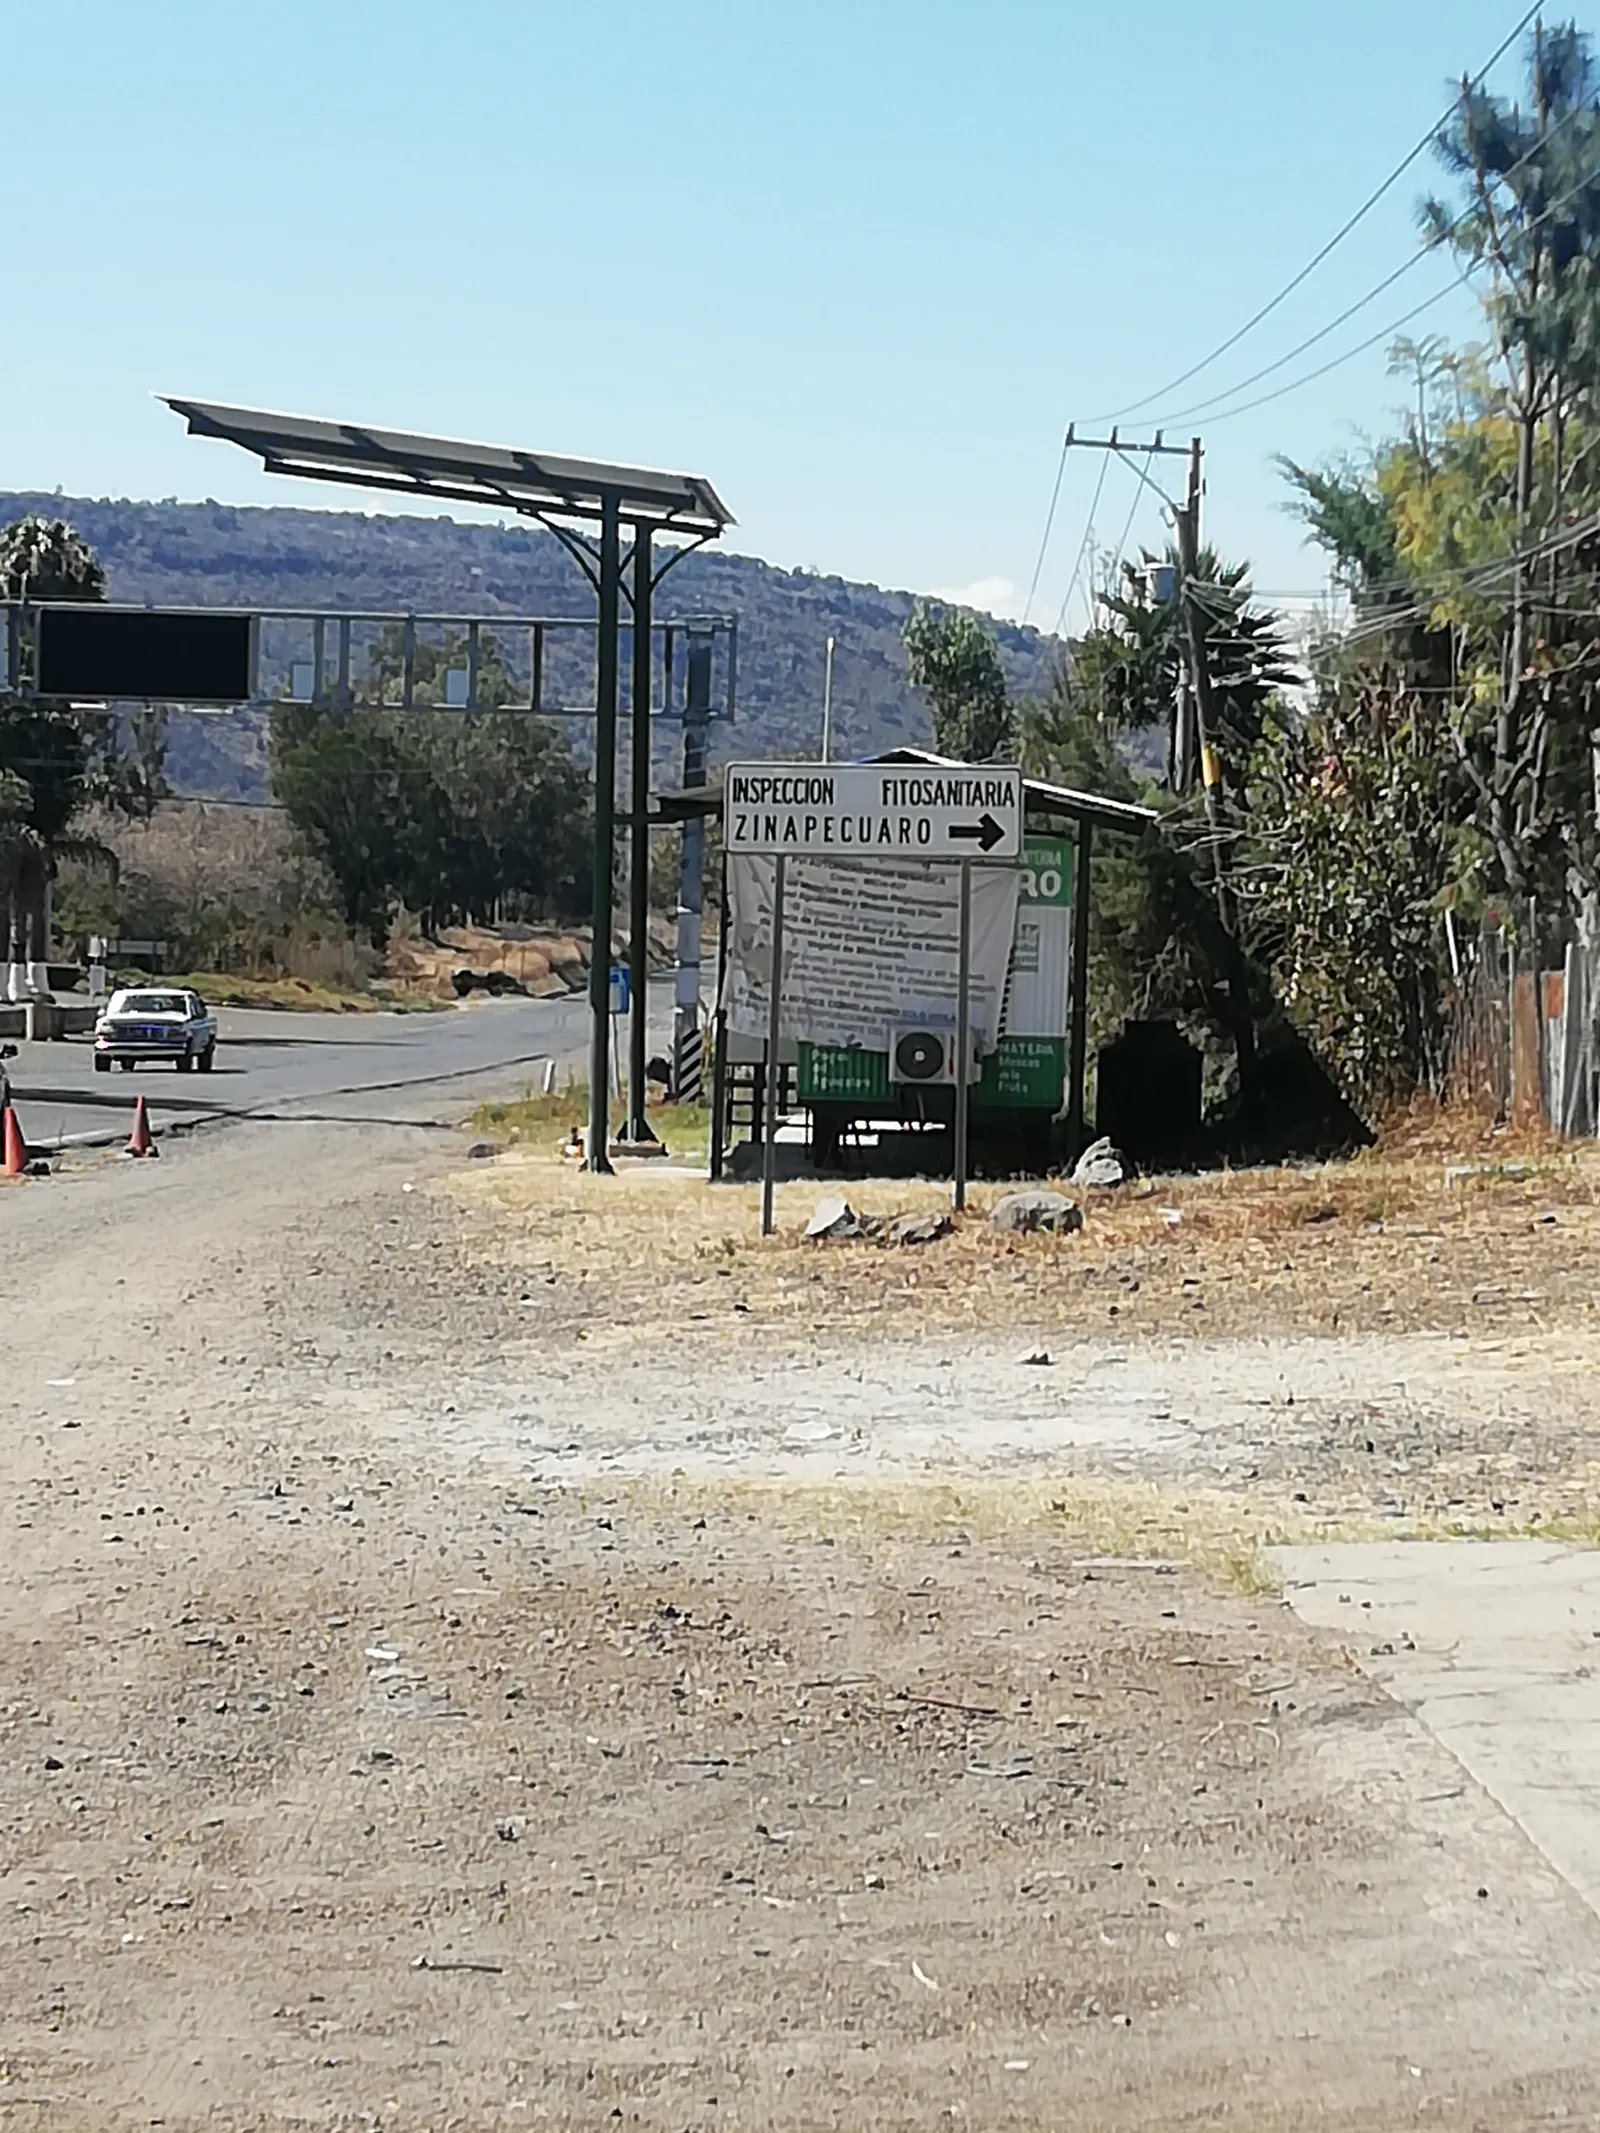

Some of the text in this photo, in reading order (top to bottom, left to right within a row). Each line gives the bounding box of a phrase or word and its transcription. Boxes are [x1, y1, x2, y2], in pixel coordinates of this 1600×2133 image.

[733, 778, 1015, 807] INSPECCION FITOSANITARIA
[735, 815, 931, 844] ZINAPECUARO
